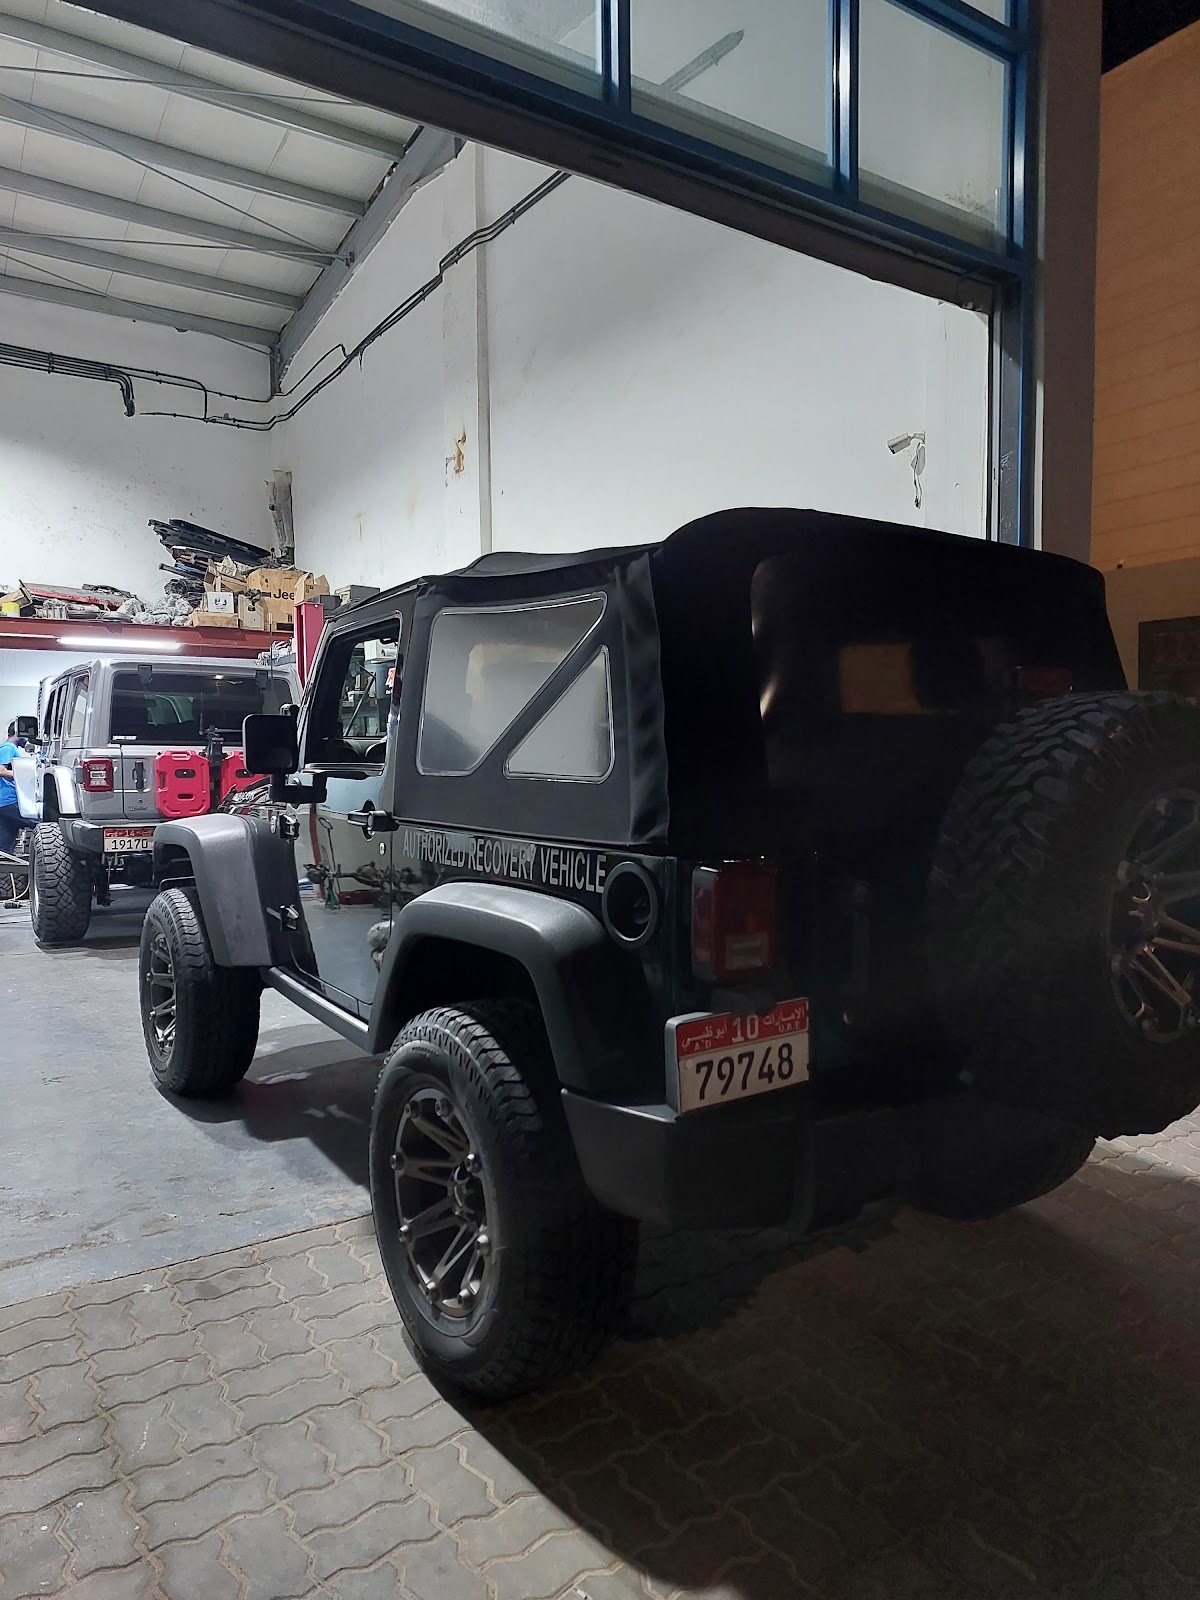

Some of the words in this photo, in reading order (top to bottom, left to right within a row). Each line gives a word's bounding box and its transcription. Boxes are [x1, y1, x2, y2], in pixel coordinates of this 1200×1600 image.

[273, 588, 295, 600] Jee
[125, 829, 135, 837] 14
[111, 838, 149, 850] 19170
[403, 828, 467, 868] AUTHORIZED
[468, 837, 536, 881] RECOVERY
[540, 847, 607, 893] VEHICLE
[732, 1014, 759, 1043] 10
[695, 1043, 793, 1101] 79748
